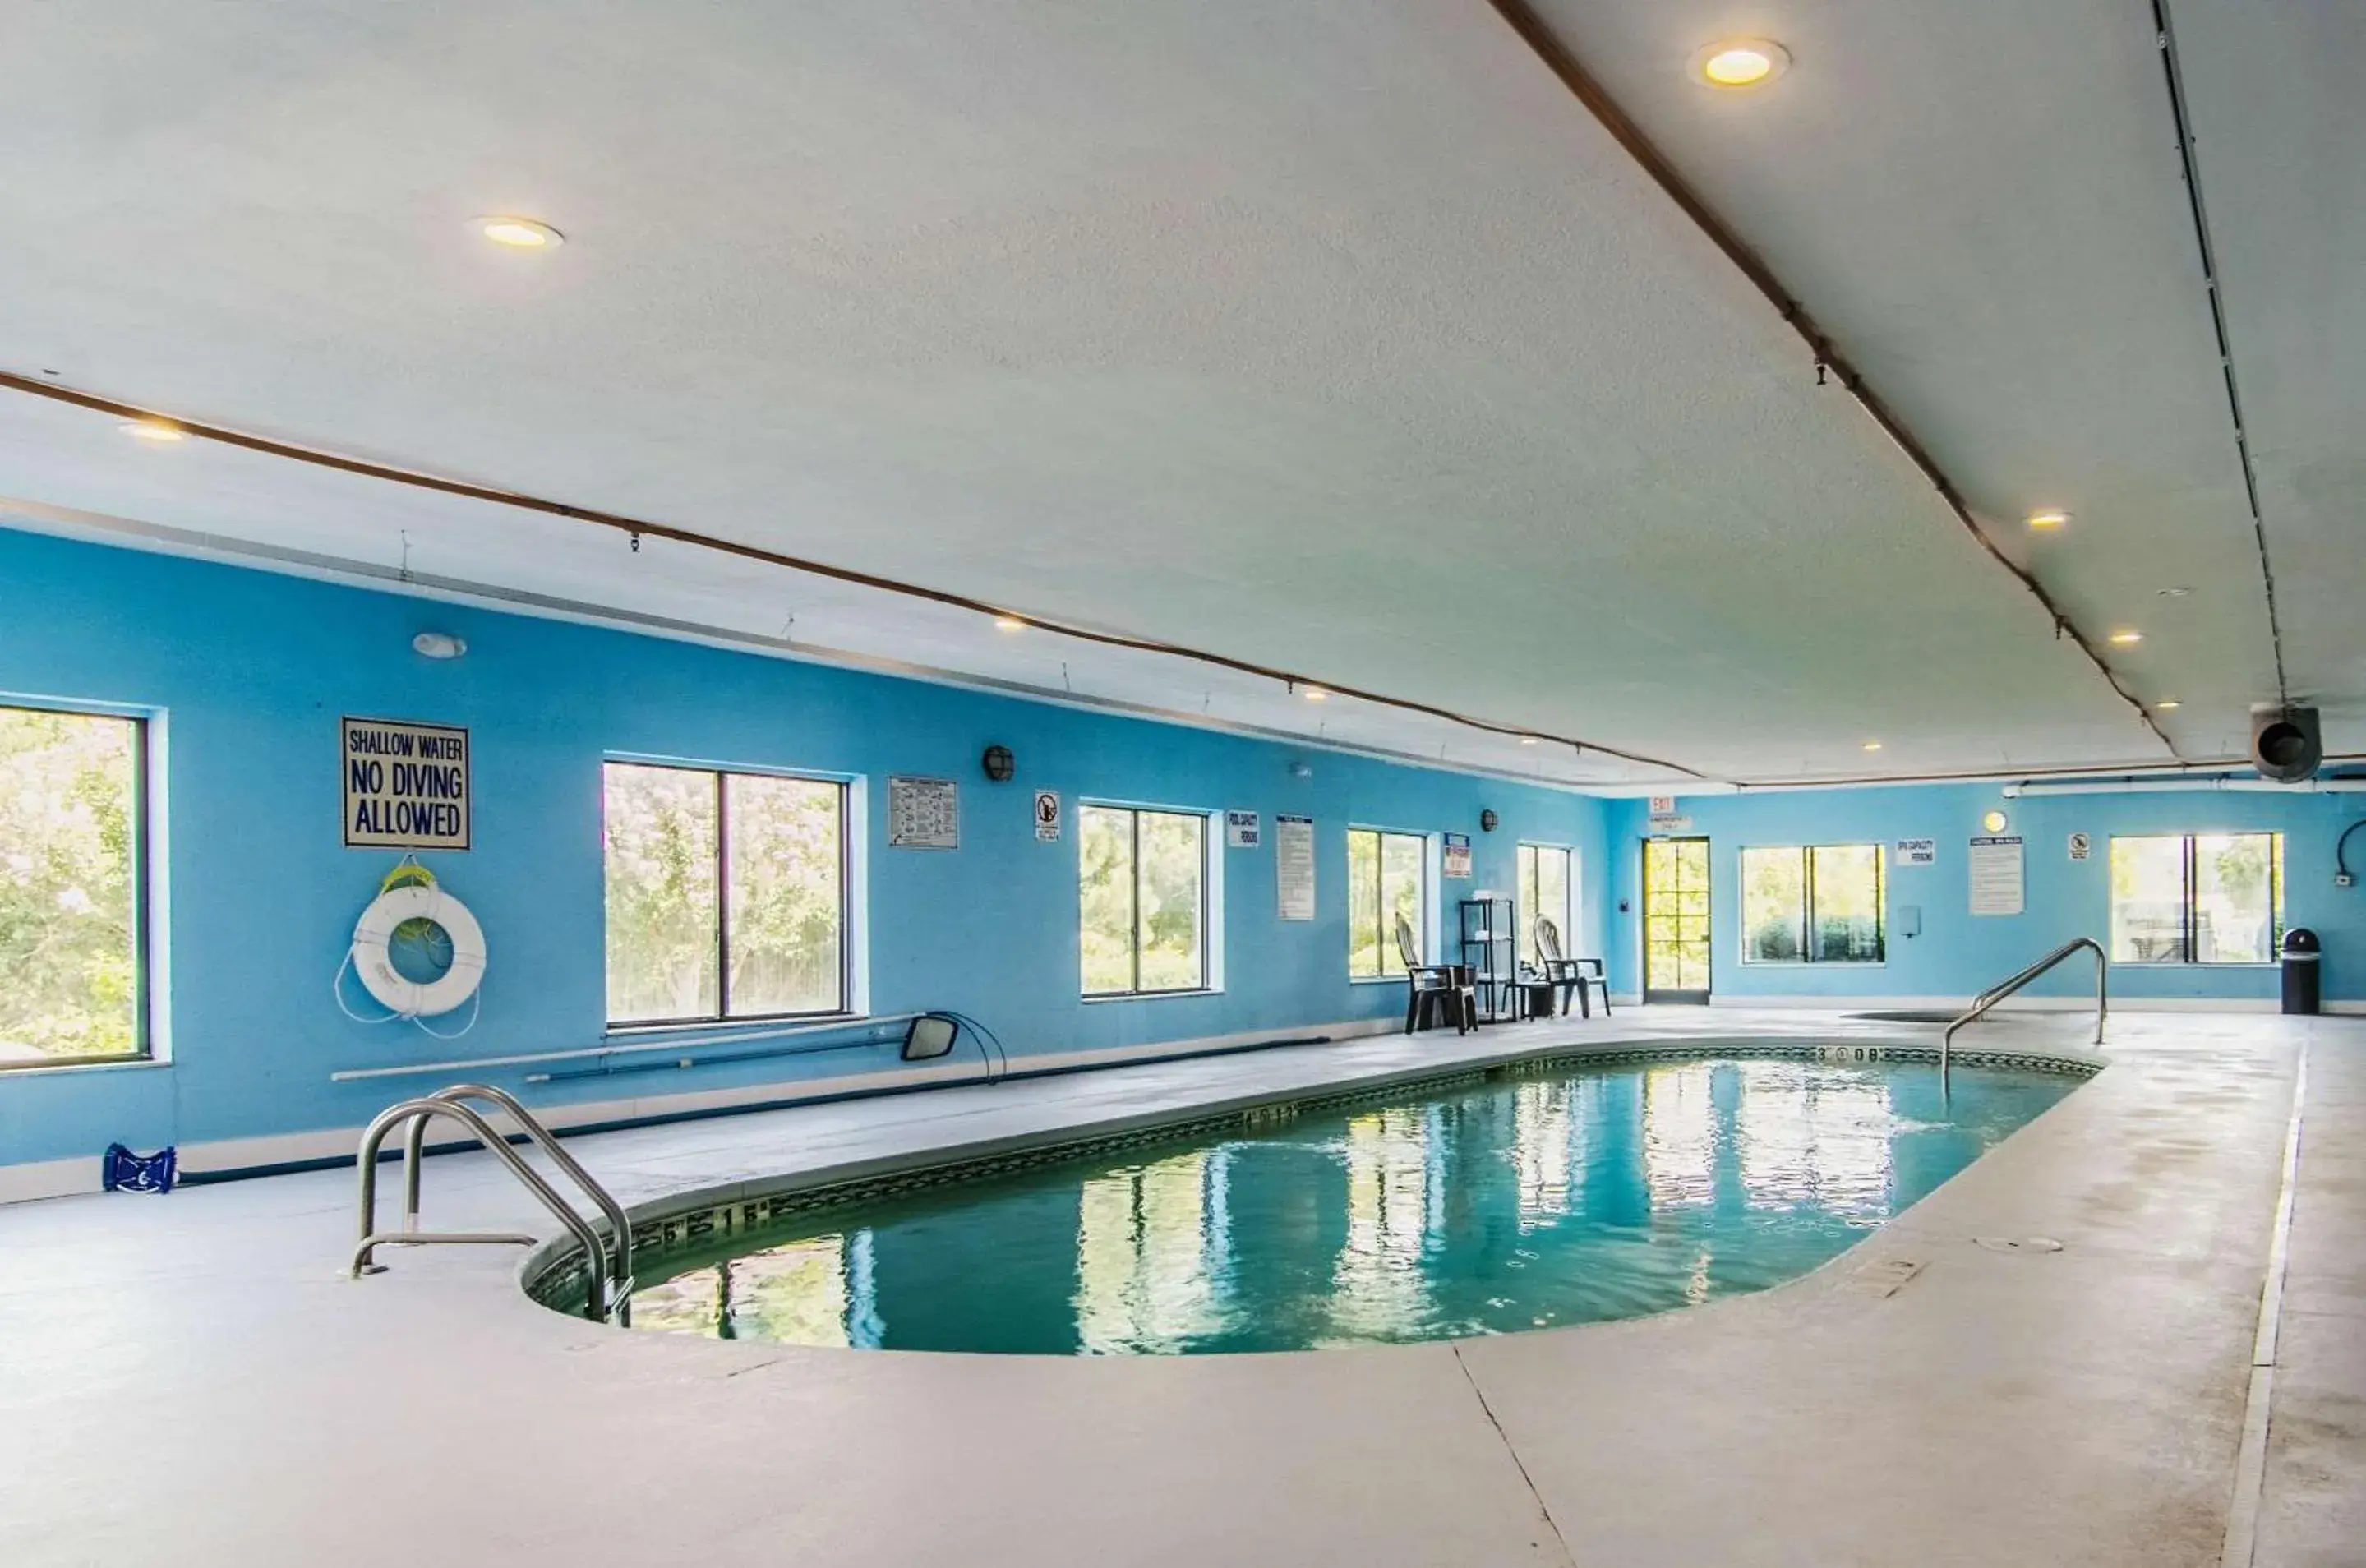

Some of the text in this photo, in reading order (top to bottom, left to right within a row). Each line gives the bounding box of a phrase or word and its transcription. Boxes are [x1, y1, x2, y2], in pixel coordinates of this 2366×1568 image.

[349, 730, 463, 761] SHALLOW WATER
[351, 759, 463, 800] NO DIVING
[354, 799, 461, 837] ALLOWED
